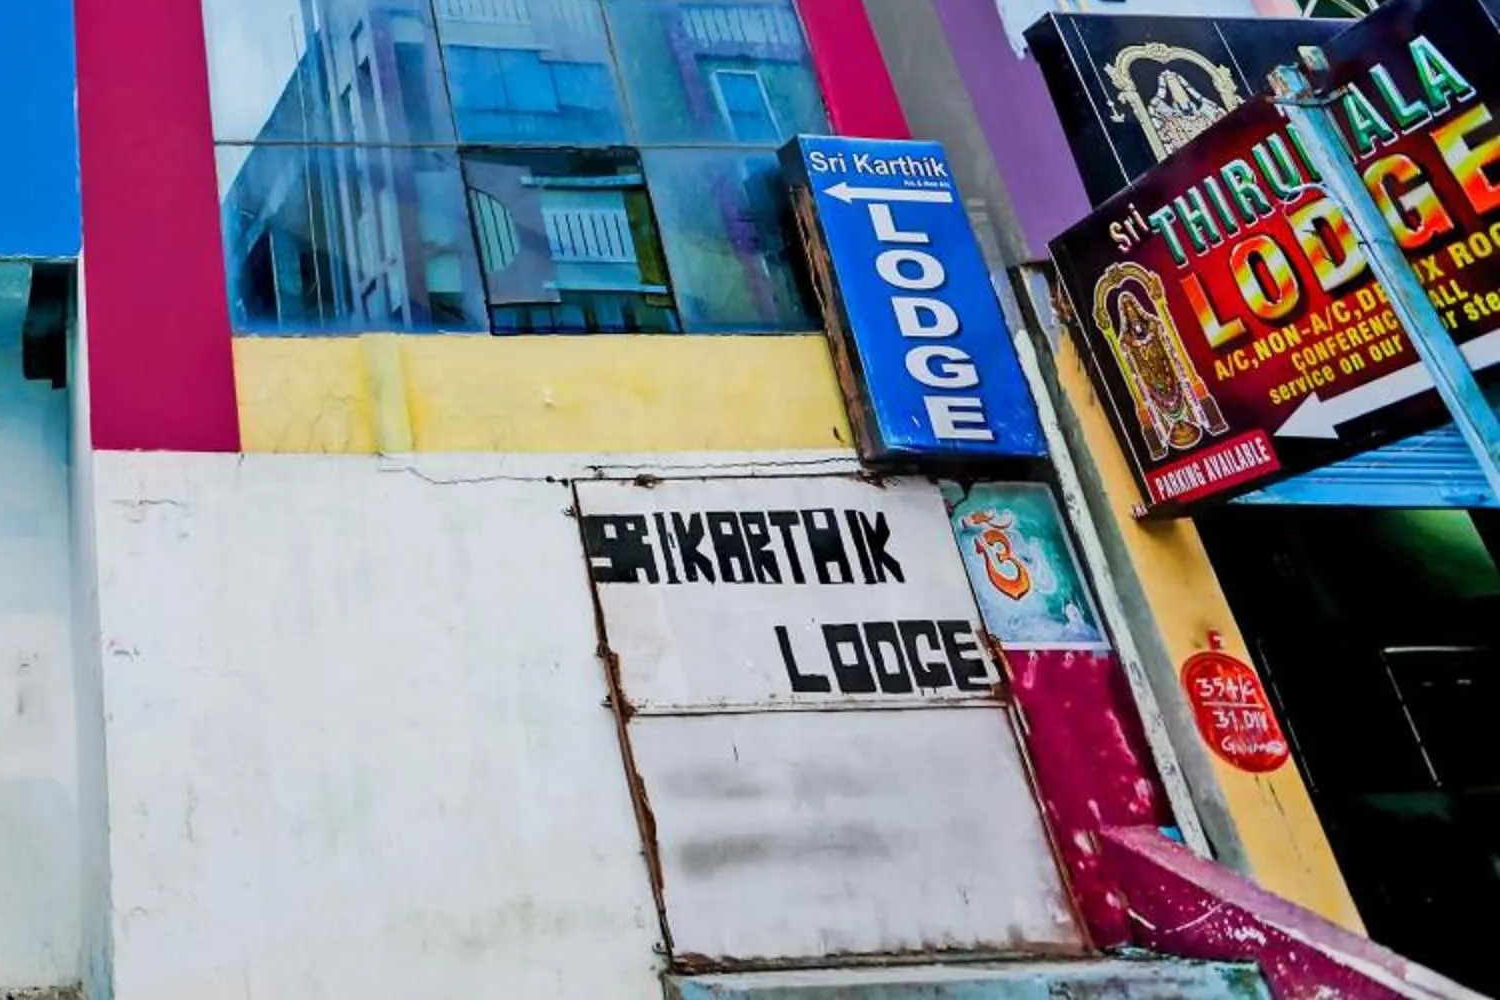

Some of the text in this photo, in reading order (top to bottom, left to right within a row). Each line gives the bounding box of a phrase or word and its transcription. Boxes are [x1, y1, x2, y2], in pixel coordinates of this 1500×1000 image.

[809, 151, 949, 178] Sri Karthik
[1109, 34, 1477, 269] Sri THIRUALA
[1180, 102, 1500, 349] LODGE
[868, 203, 995, 442] LODGE
[1291, 310, 1399, 373] CONFERENC
[1269, 365, 1336, 405] service
[1339, 352, 1366, 376] on
[1368, 334, 1404, 363] our
[1155, 436, 1272, 501] PARKING AVAILABLE
[774, 619, 992, 694] LODGE
